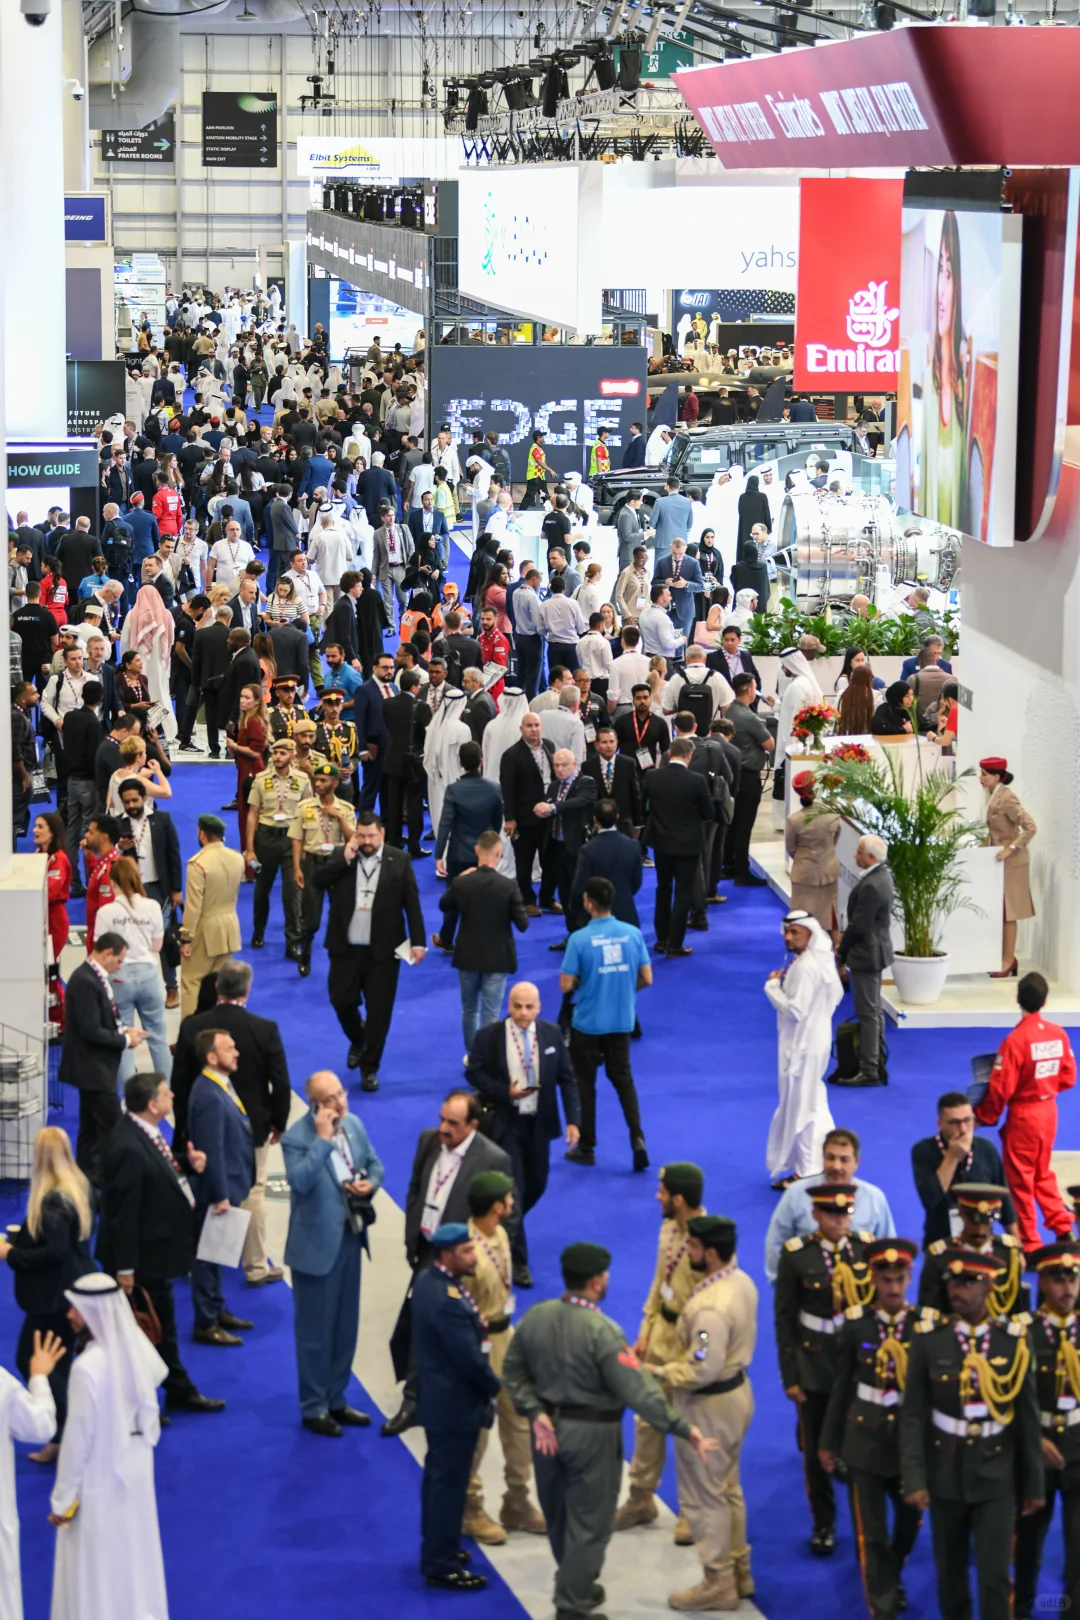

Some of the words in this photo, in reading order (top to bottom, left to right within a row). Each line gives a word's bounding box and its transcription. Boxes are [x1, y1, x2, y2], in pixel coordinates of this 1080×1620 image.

[309, 153, 331, 161] Elbit
[333, 154, 371, 163] Systems
[741, 244, 797, 274] yahs
[444, 398, 622, 447] EDGE
[8, 465, 42, 477] HOW
[43, 463, 81, 476] GUIDE
